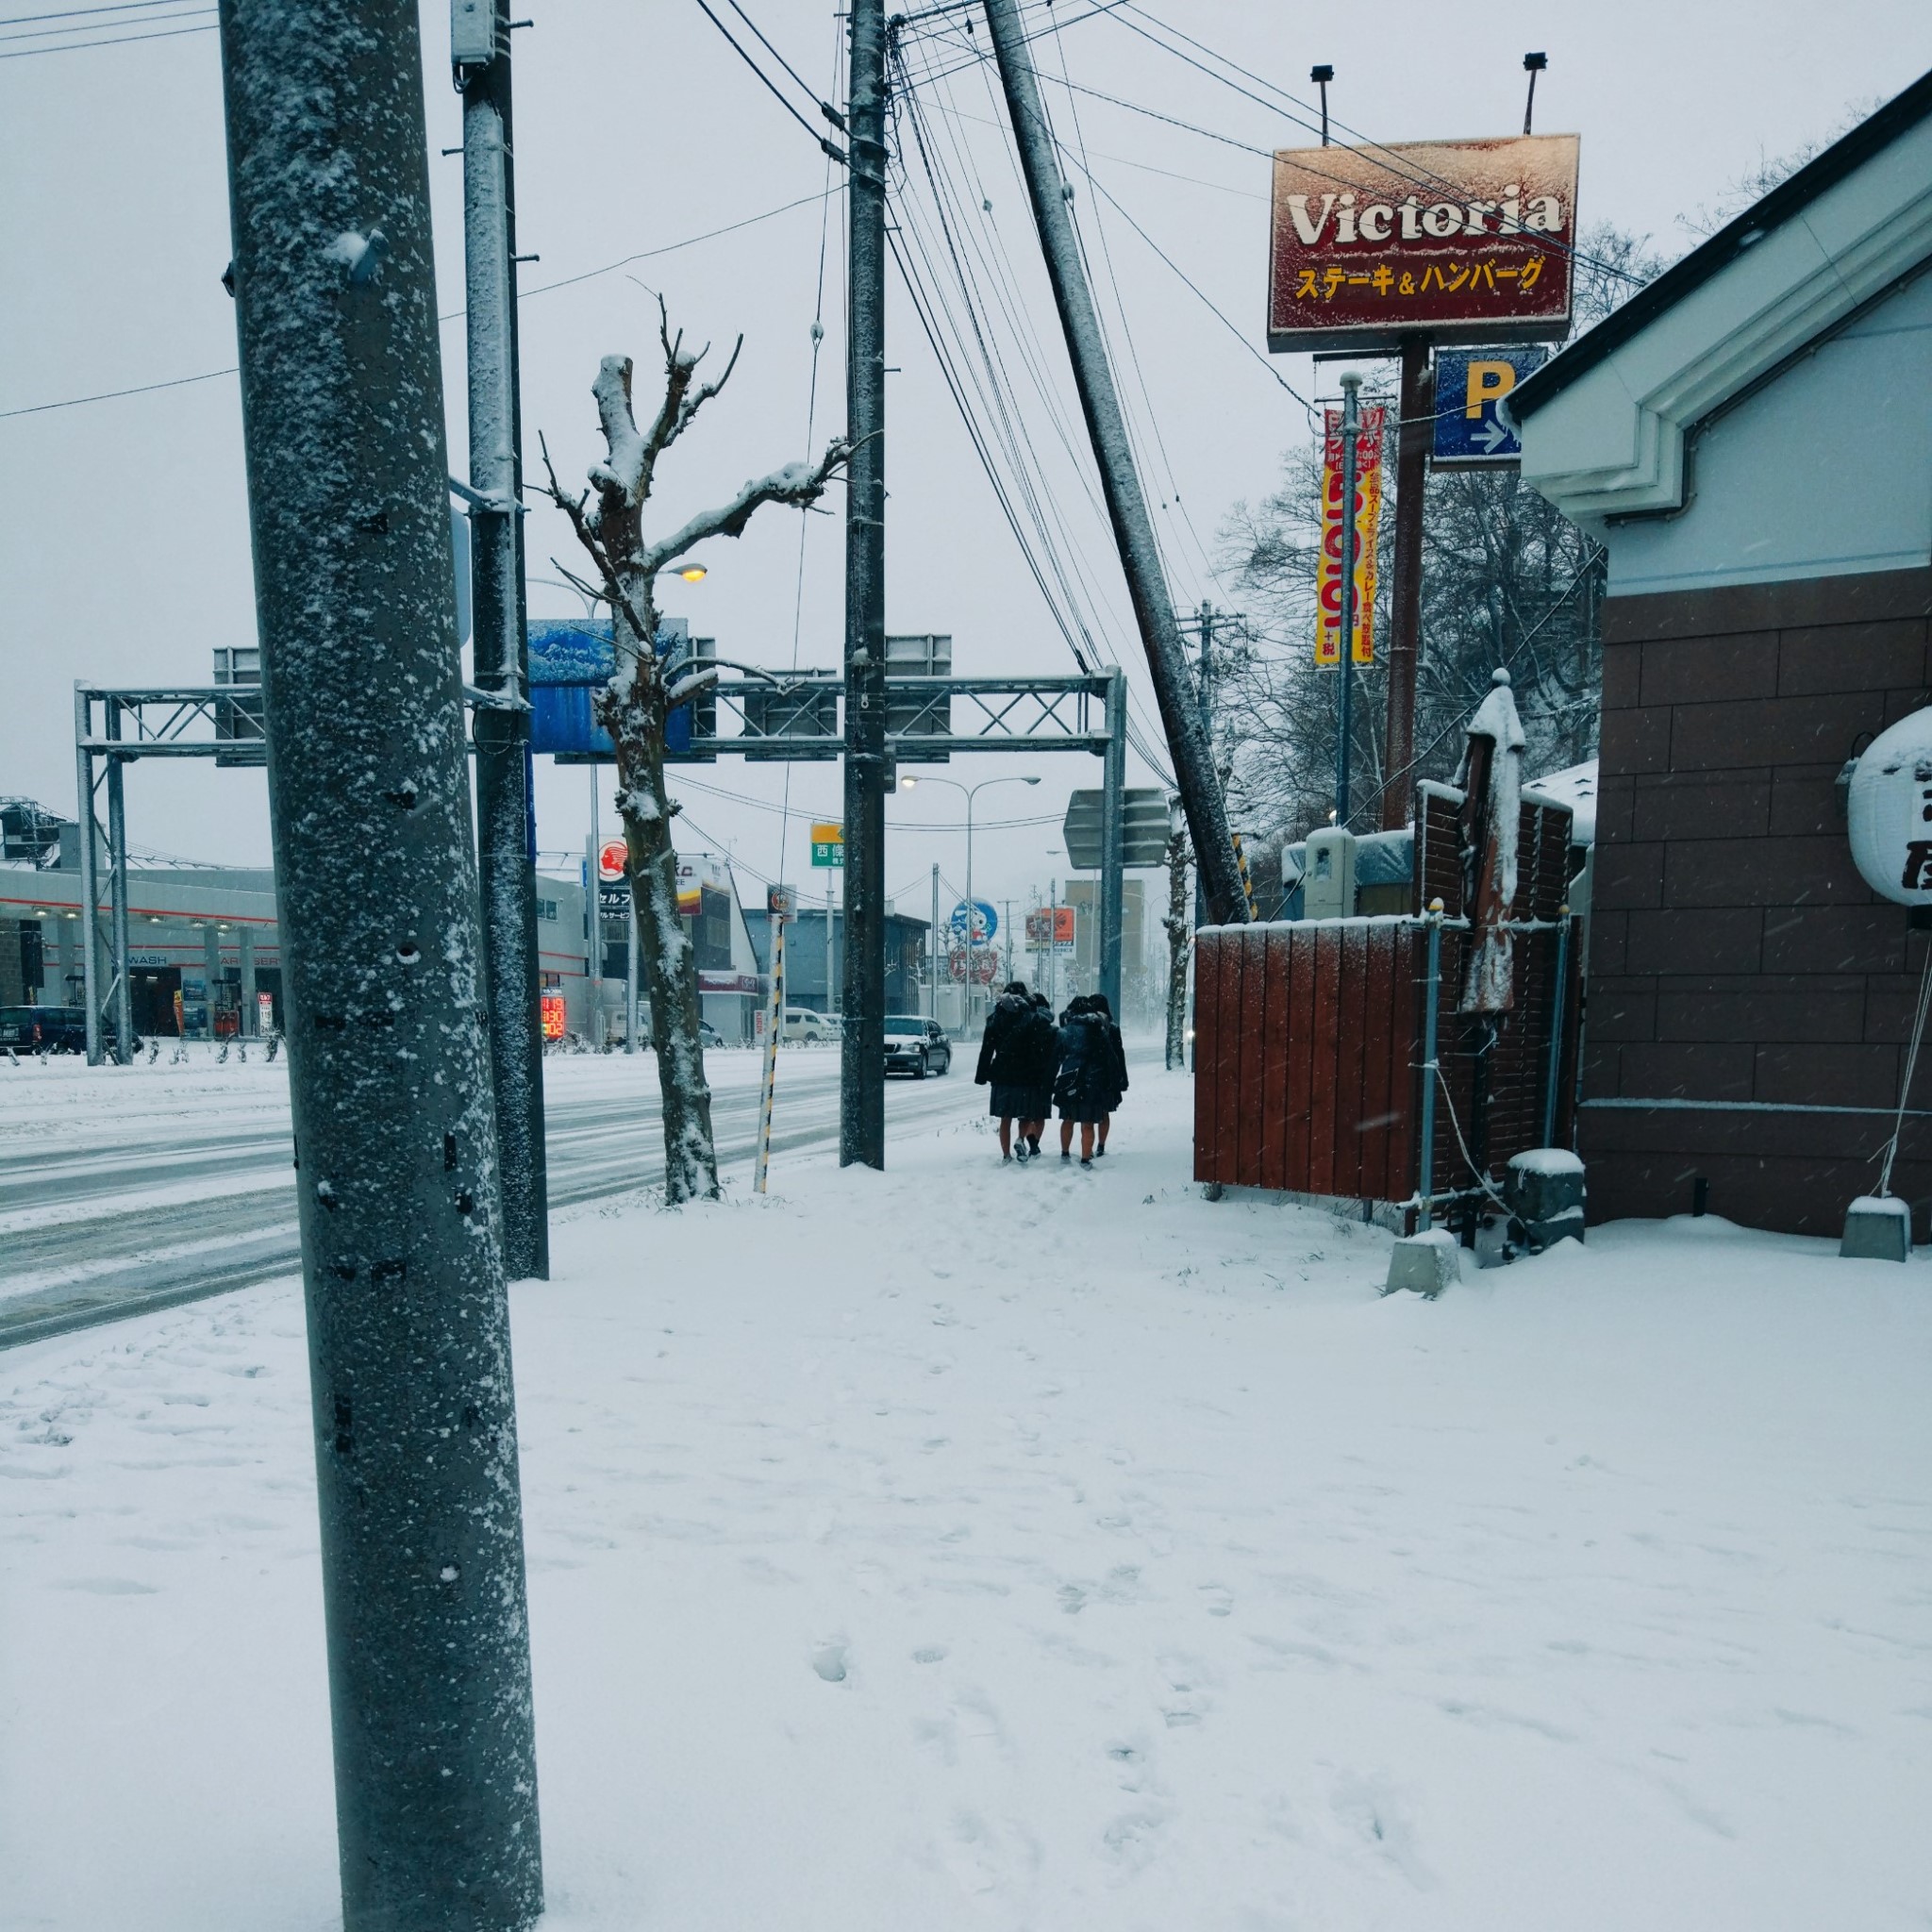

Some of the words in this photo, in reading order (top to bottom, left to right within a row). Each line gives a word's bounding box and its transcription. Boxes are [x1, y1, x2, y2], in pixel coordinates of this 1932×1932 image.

[1287, 184, 1564, 245] Victoria
[1466, 360, 1516, 418] P
[599, 892, 630, 905] セルフ
